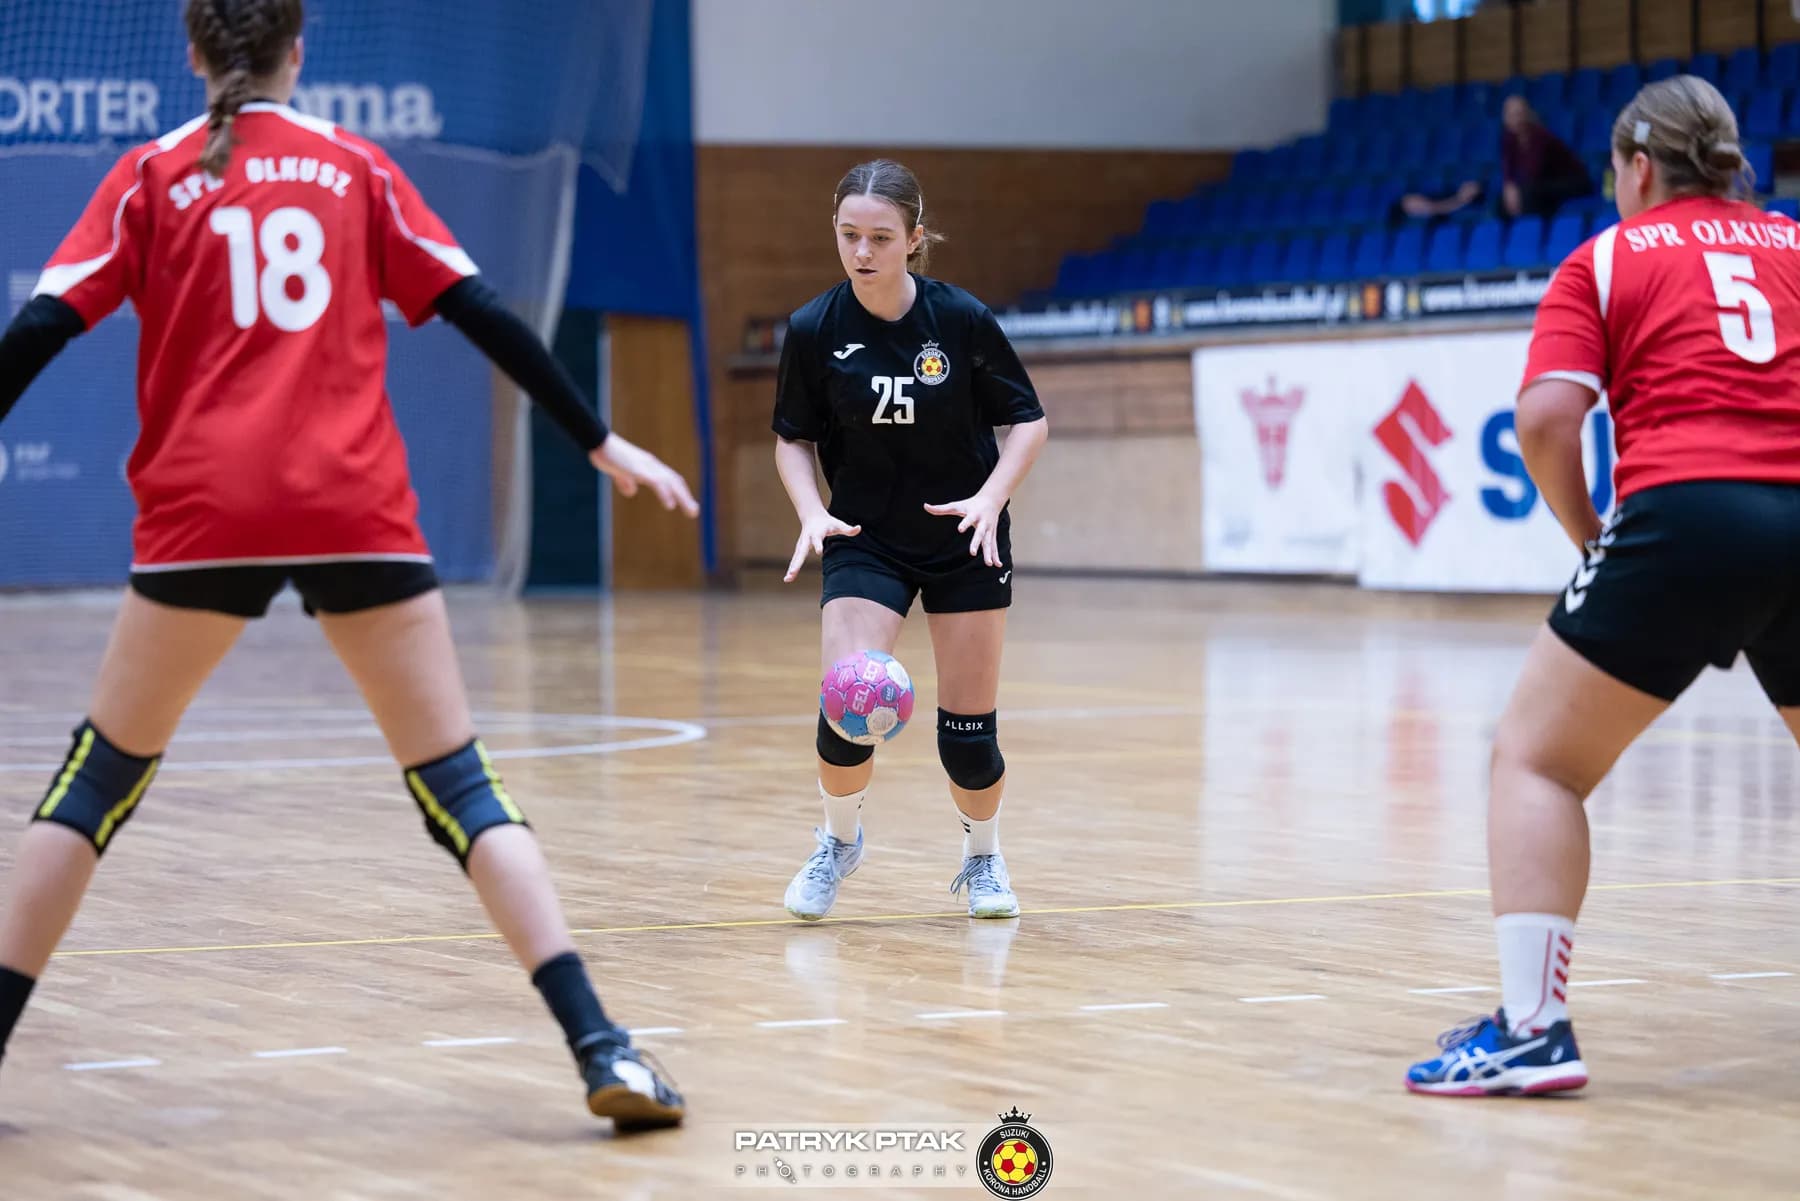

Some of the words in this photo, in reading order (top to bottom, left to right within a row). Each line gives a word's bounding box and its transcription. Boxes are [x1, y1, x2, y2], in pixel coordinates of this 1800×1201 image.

[245, 156, 352, 198] OLKUSZ
[1624, 222, 1686, 252] SPR
[210, 207, 332, 332] 18
[1703, 252, 1777, 364] 5
[871, 376, 915, 424] 25
[945, 720, 983, 731] ALLSIX
